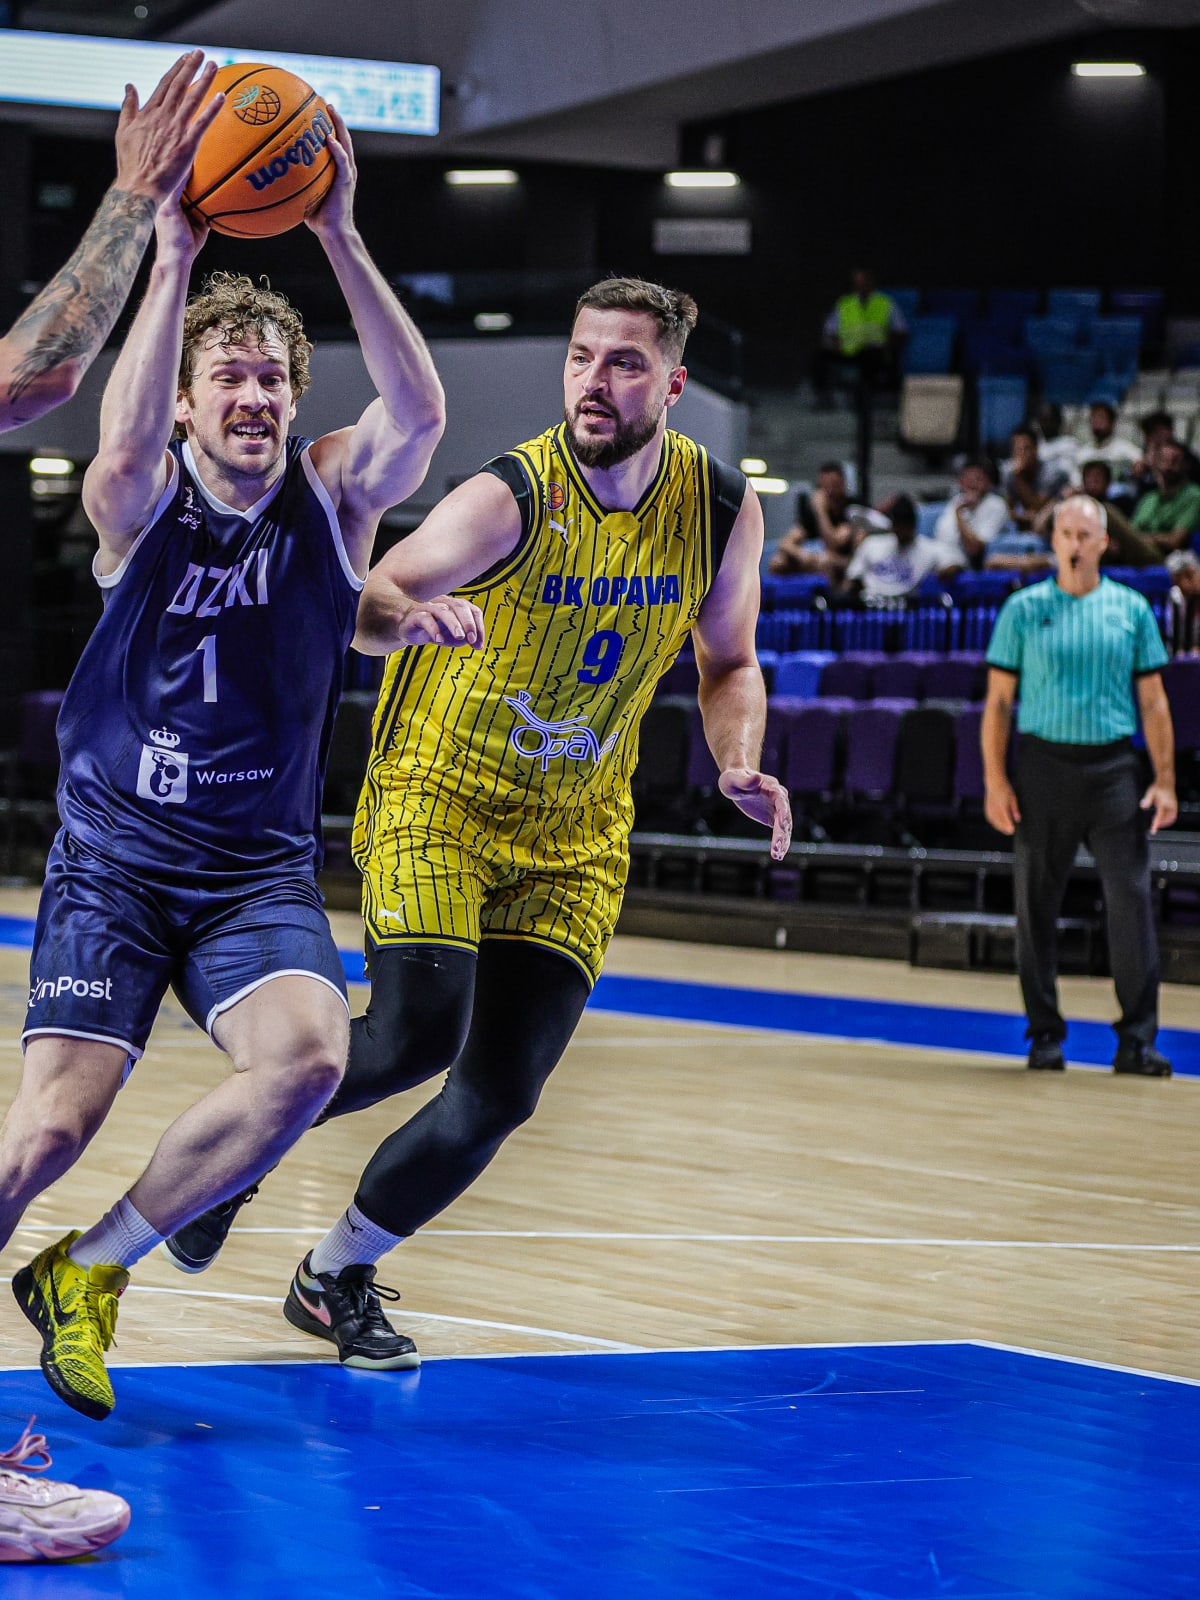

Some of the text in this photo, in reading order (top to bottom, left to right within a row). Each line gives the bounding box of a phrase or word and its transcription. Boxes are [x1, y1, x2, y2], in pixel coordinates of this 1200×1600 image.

[542, 574, 680, 607] BK OPAVA
[196, 634, 218, 703] 1
[577, 629, 623, 685] 9
[195, 767, 274, 785] Warsaw
